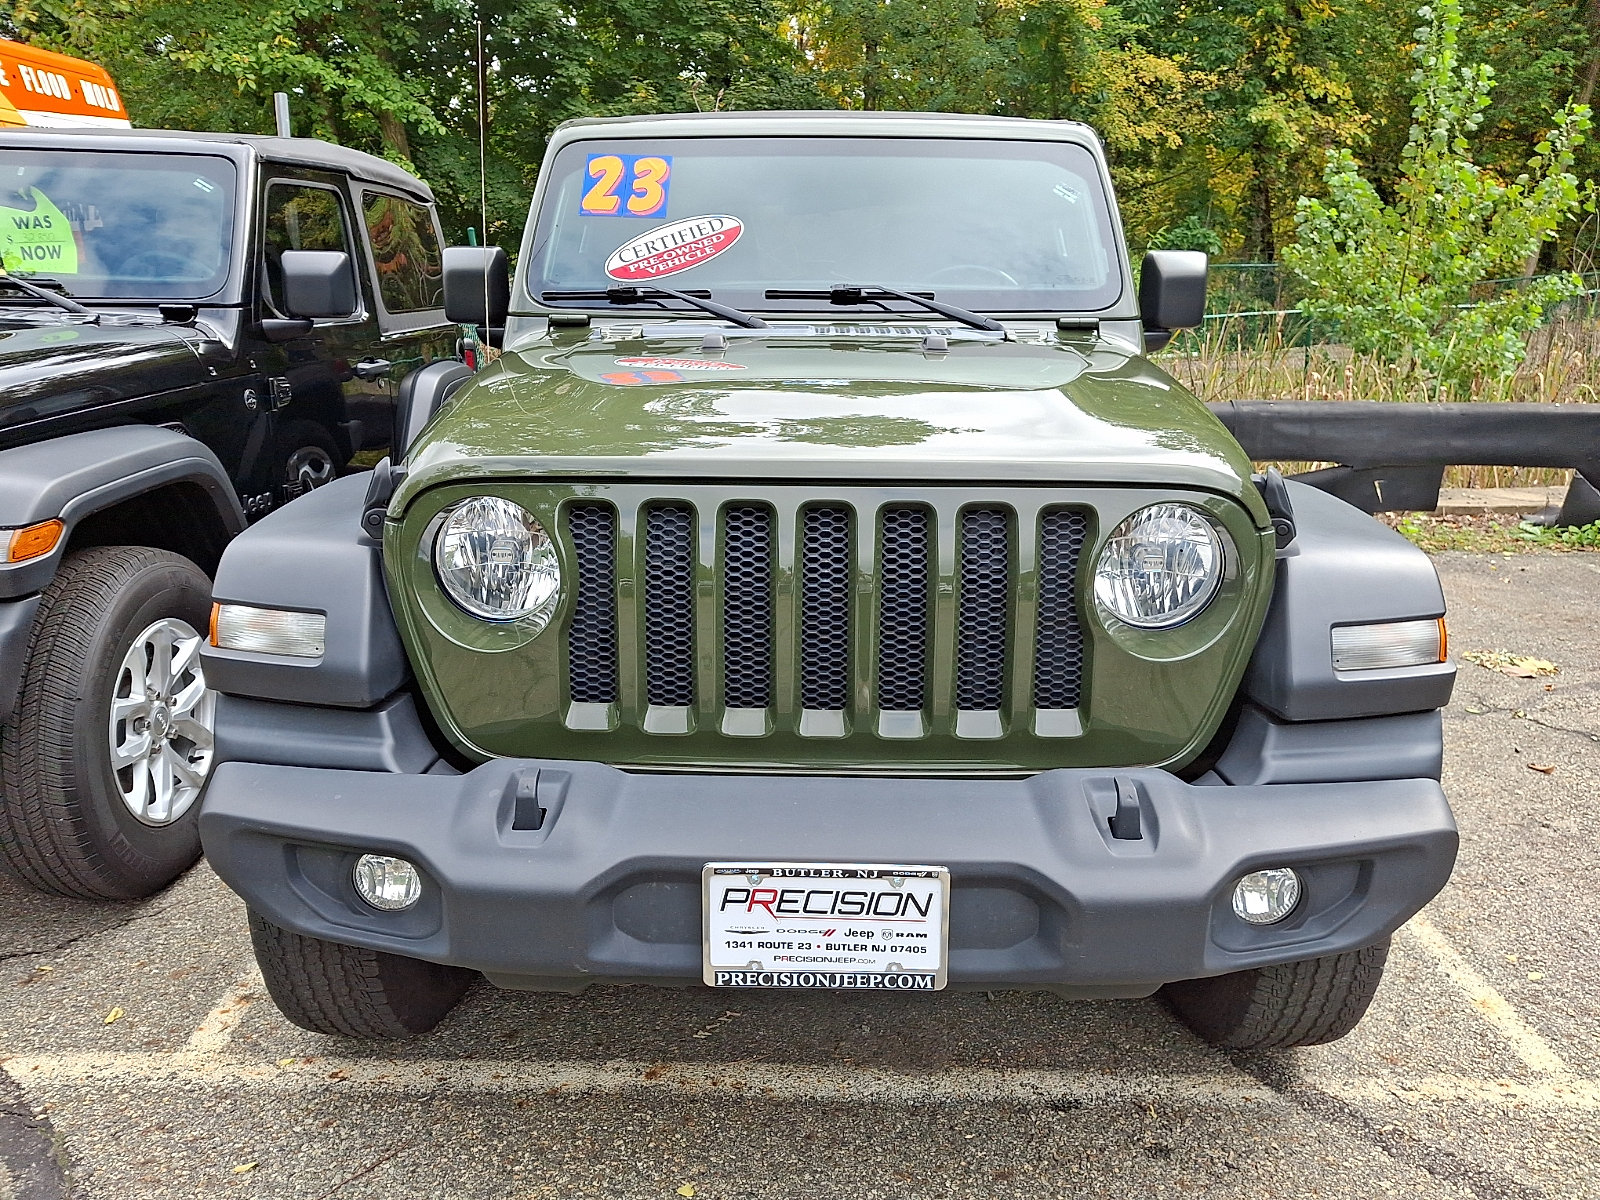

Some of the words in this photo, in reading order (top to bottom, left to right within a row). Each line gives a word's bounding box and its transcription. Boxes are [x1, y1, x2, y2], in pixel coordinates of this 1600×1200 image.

[18, 64, 72, 100] FLOOD
[79, 79, 120, 112] MOLD
[581, 155, 670, 216] 23
[12, 215, 52, 230] WAS
[618, 218, 724, 263] CERTIFIED
[20, 245, 62, 260] NOW
[628, 234, 725, 273] PRE-OWNED
[645, 245, 716, 274] VEHICLE
[772, 868, 850, 878] BUTLER,
[856, 869, 879, 879] NJ
[720, 888, 933, 917] PRECISION
[844, 928, 875, 940] Jeep
[725, 941, 753, 949] 1341
[757, 941, 794, 950] ROUTE
[797, 942, 812, 950] 23
[825, 943, 868, 952] BUTLER
[871, 944, 887, 953] NJ
[890, 945, 927, 954] 07405
[773, 955, 876, 964] PRECISIONJEEP.COM
[715, 971, 934, 990] PRECISIONJEEP.COM
